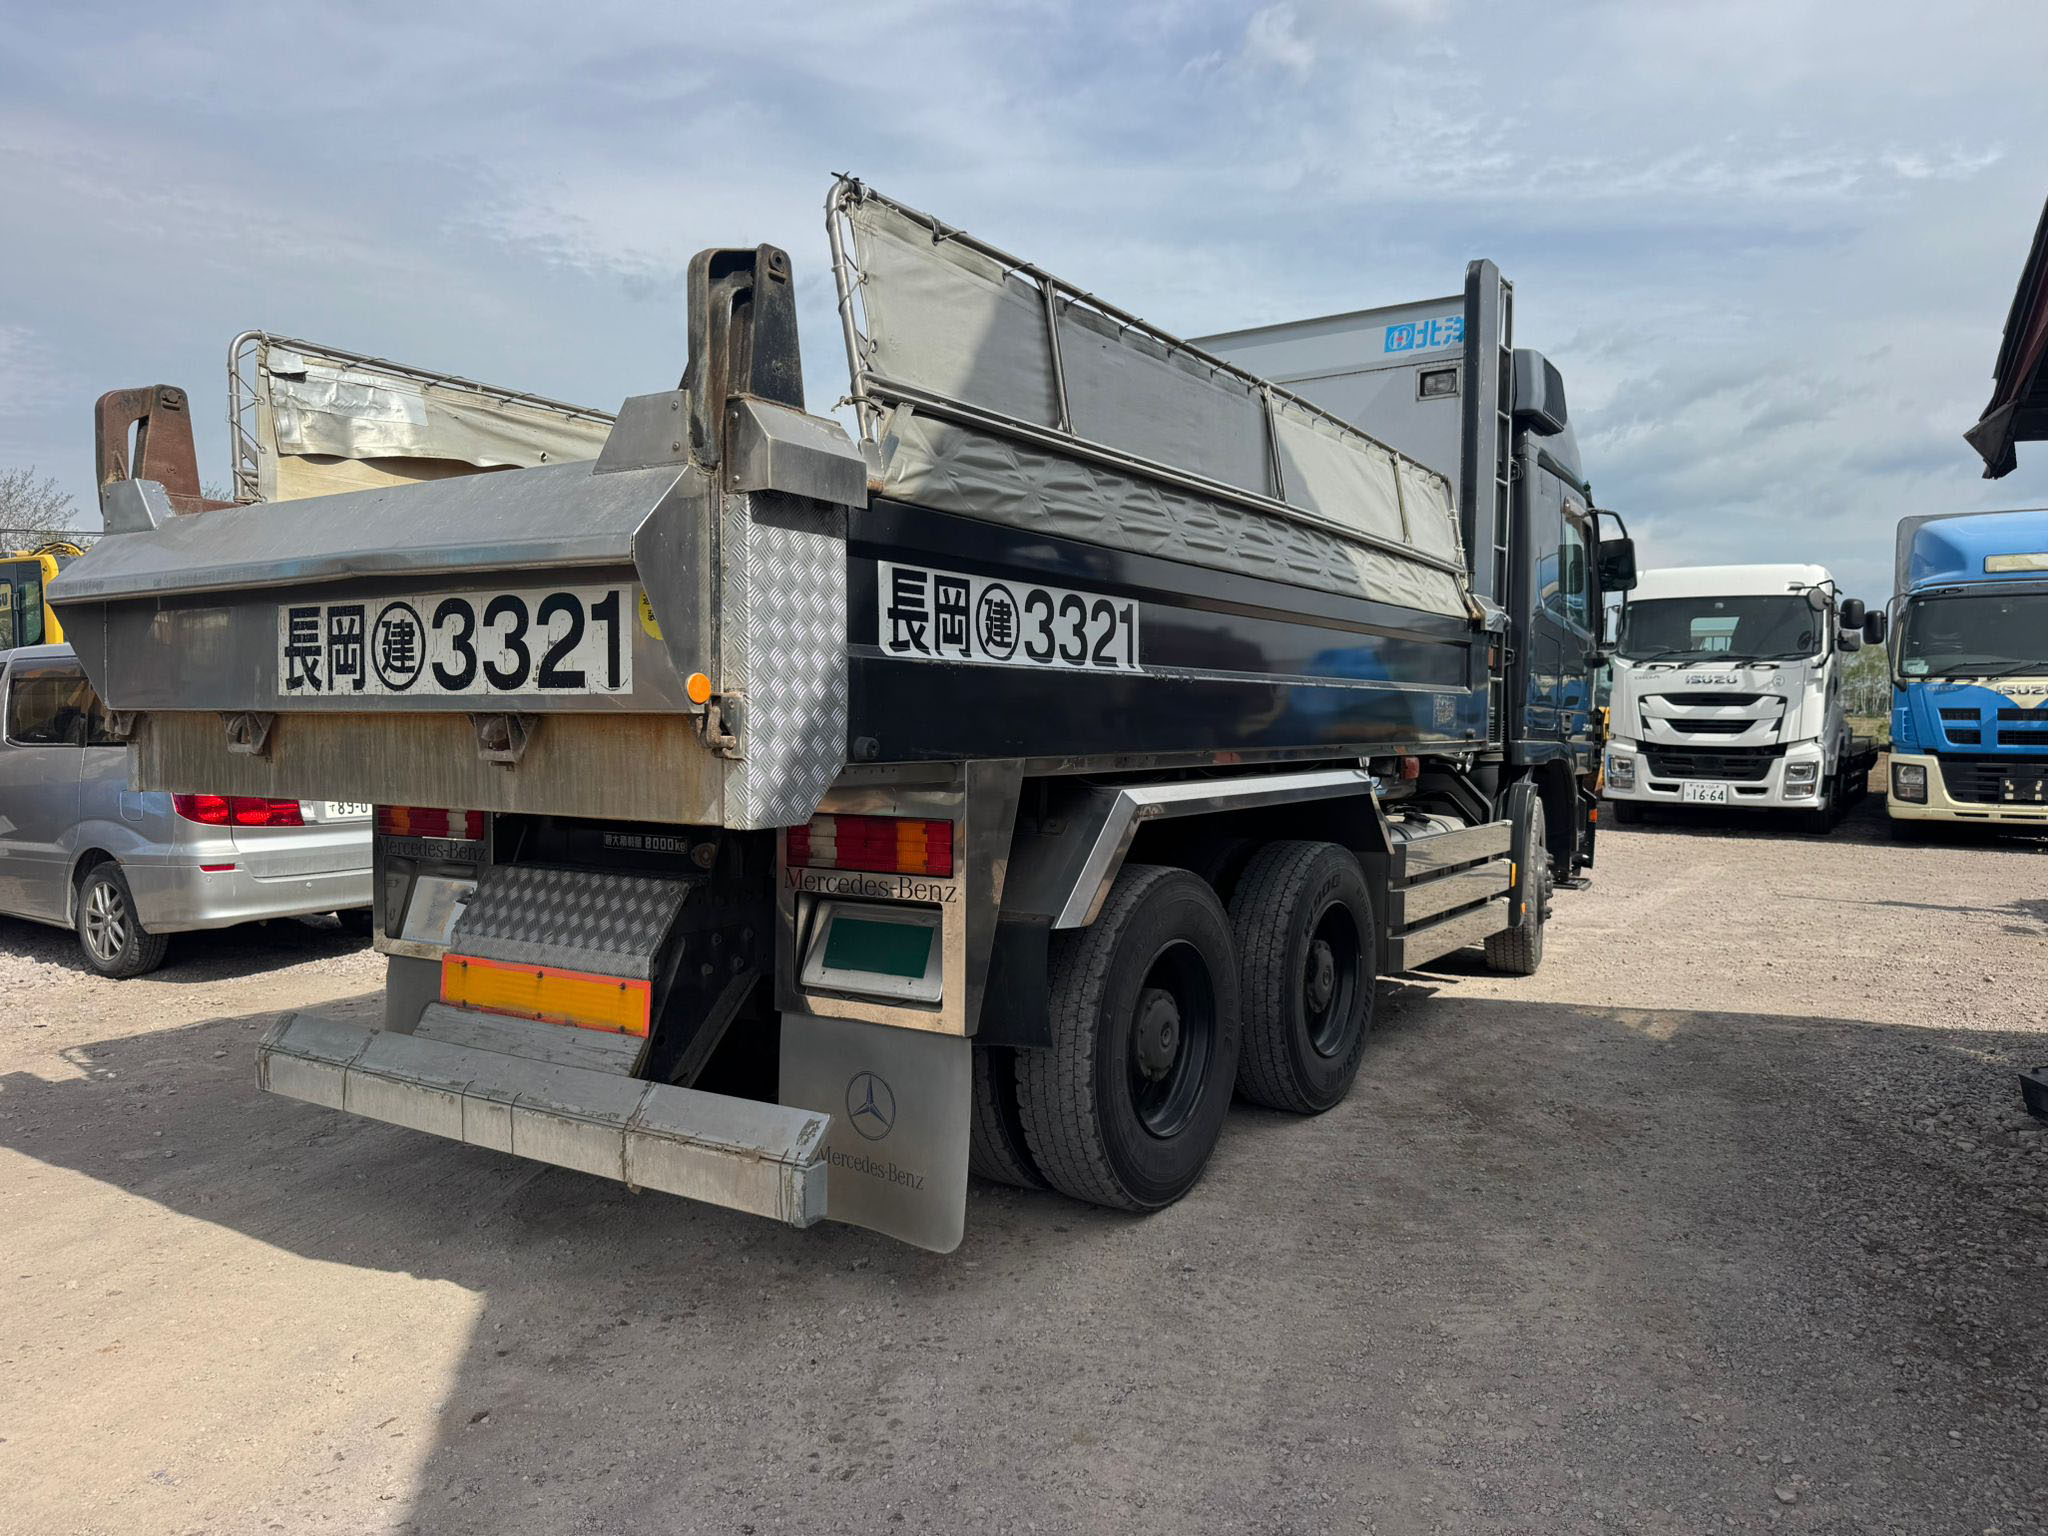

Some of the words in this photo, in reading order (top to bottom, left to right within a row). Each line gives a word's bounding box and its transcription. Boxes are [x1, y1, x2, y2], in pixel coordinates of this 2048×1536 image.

[1685, 674, 1738, 685] ISUZU
[376, 836, 487, 861] Mercedes-Benz
[645, 836, 686, 852] 8000kg
[785, 868, 957, 903] Mercedes-Benz
[817, 1145, 925, 1190] Mercedes-Benz
